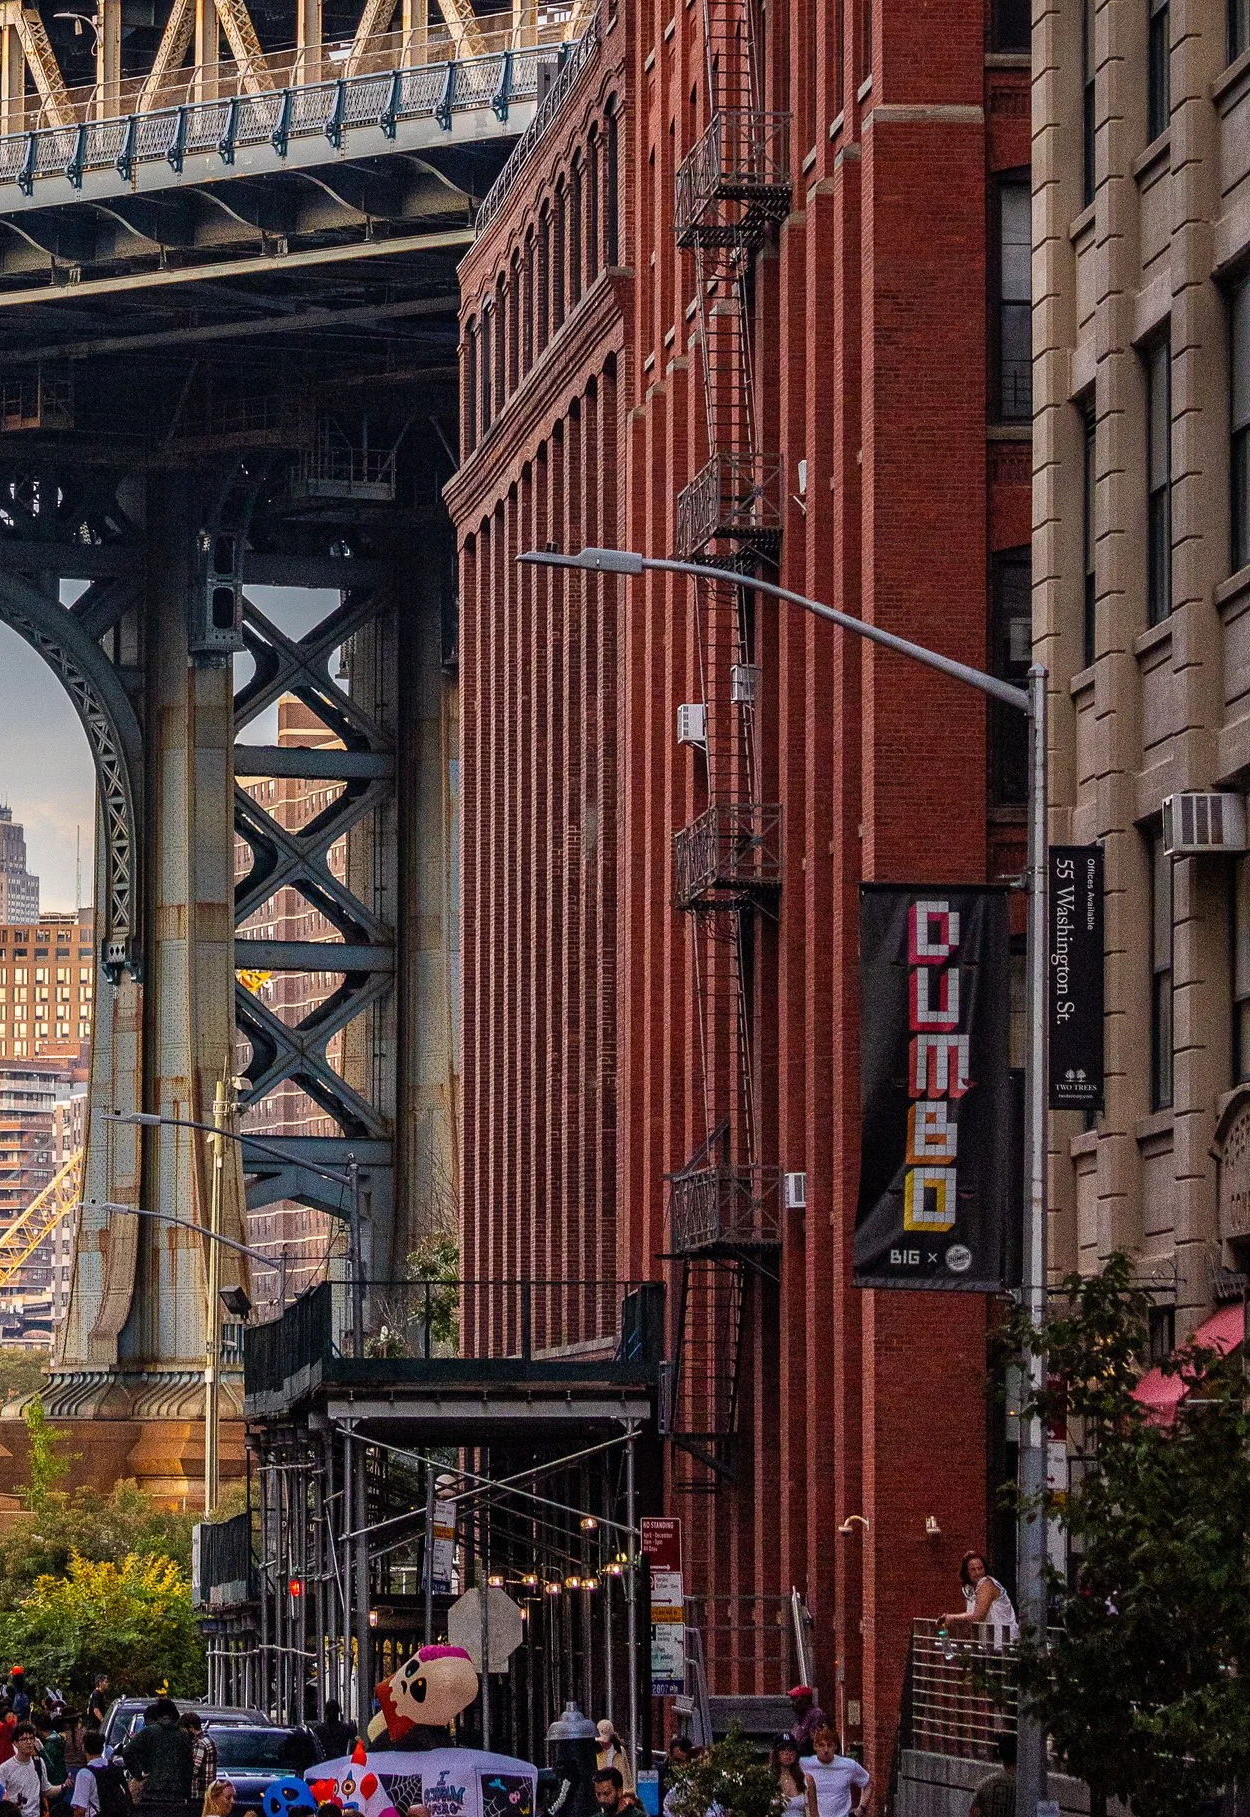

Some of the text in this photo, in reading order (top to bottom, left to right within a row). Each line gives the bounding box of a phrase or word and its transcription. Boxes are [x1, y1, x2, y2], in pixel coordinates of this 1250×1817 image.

[1087, 858, 1095, 931] Offices Available
[1051, 858, 1075, 1025] 55 Washington St.
[903, 900, 970, 1232] DUMBO
[890, 1249, 920, 1264] BIG
[642, 1521, 674, 1529] NO STANDING
